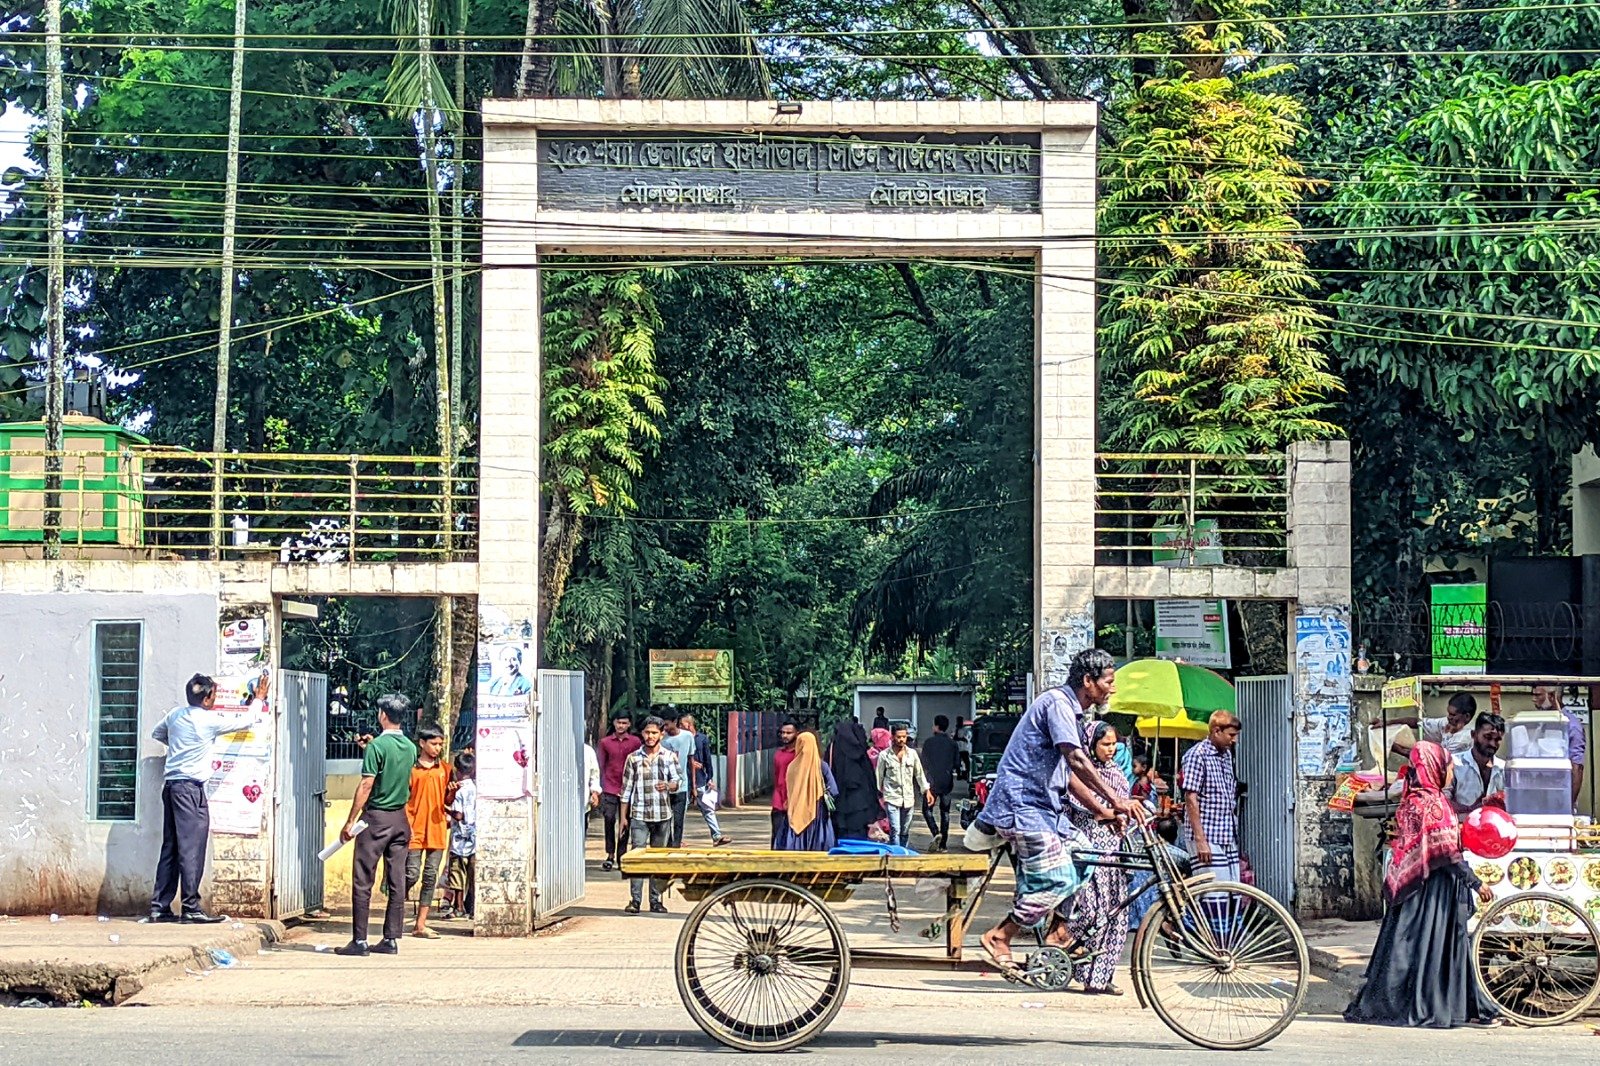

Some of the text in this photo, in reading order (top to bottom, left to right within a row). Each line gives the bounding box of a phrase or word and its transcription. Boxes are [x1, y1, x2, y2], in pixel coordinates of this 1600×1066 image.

[548, 139, 813, 172] ২৫০ শয্যা জেনারেল হাসপাতাল
[825, 135, 881, 171] সিভিল
[888, 136, 958, 172] সার্জনের
[621, 178, 739, 205] মৌলভীবাজার
[870, 179, 988, 206] মৌলভীবাজার
